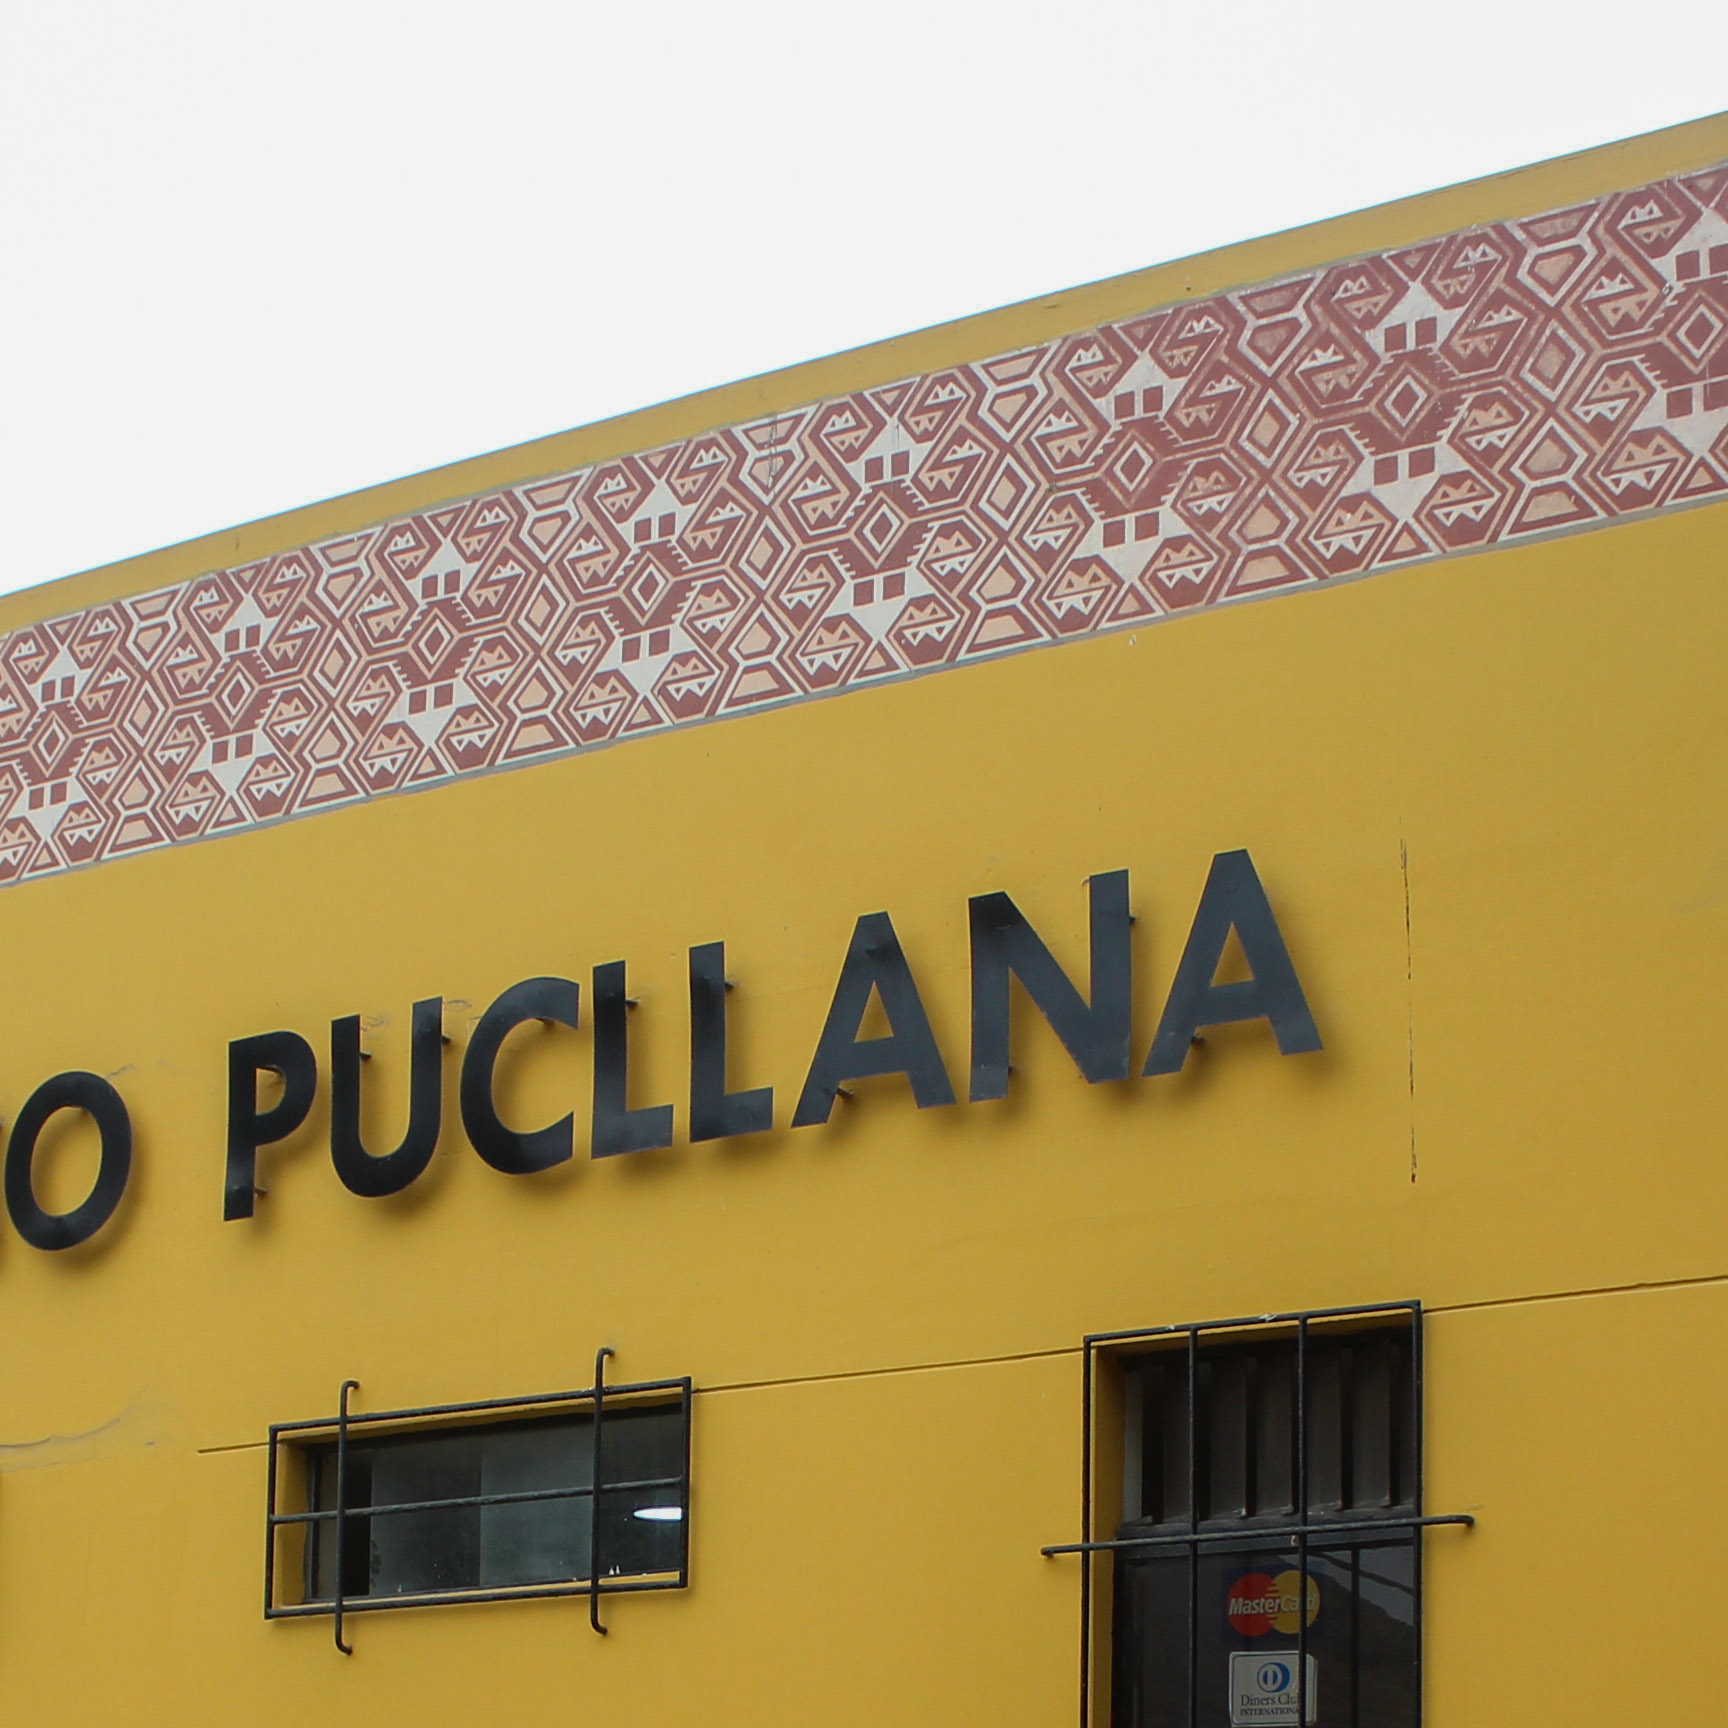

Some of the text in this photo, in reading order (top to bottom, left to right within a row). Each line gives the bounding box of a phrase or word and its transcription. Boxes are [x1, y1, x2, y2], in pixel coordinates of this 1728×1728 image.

[222, 847, 1324, 1223] PUCLLANA
[1228, 1595, 1315, 1615] MasterCad
[1240, 1693, 1300, 1706] Diners Clu
[1240, 1707, 1301, 1716] INTERNATIONA
